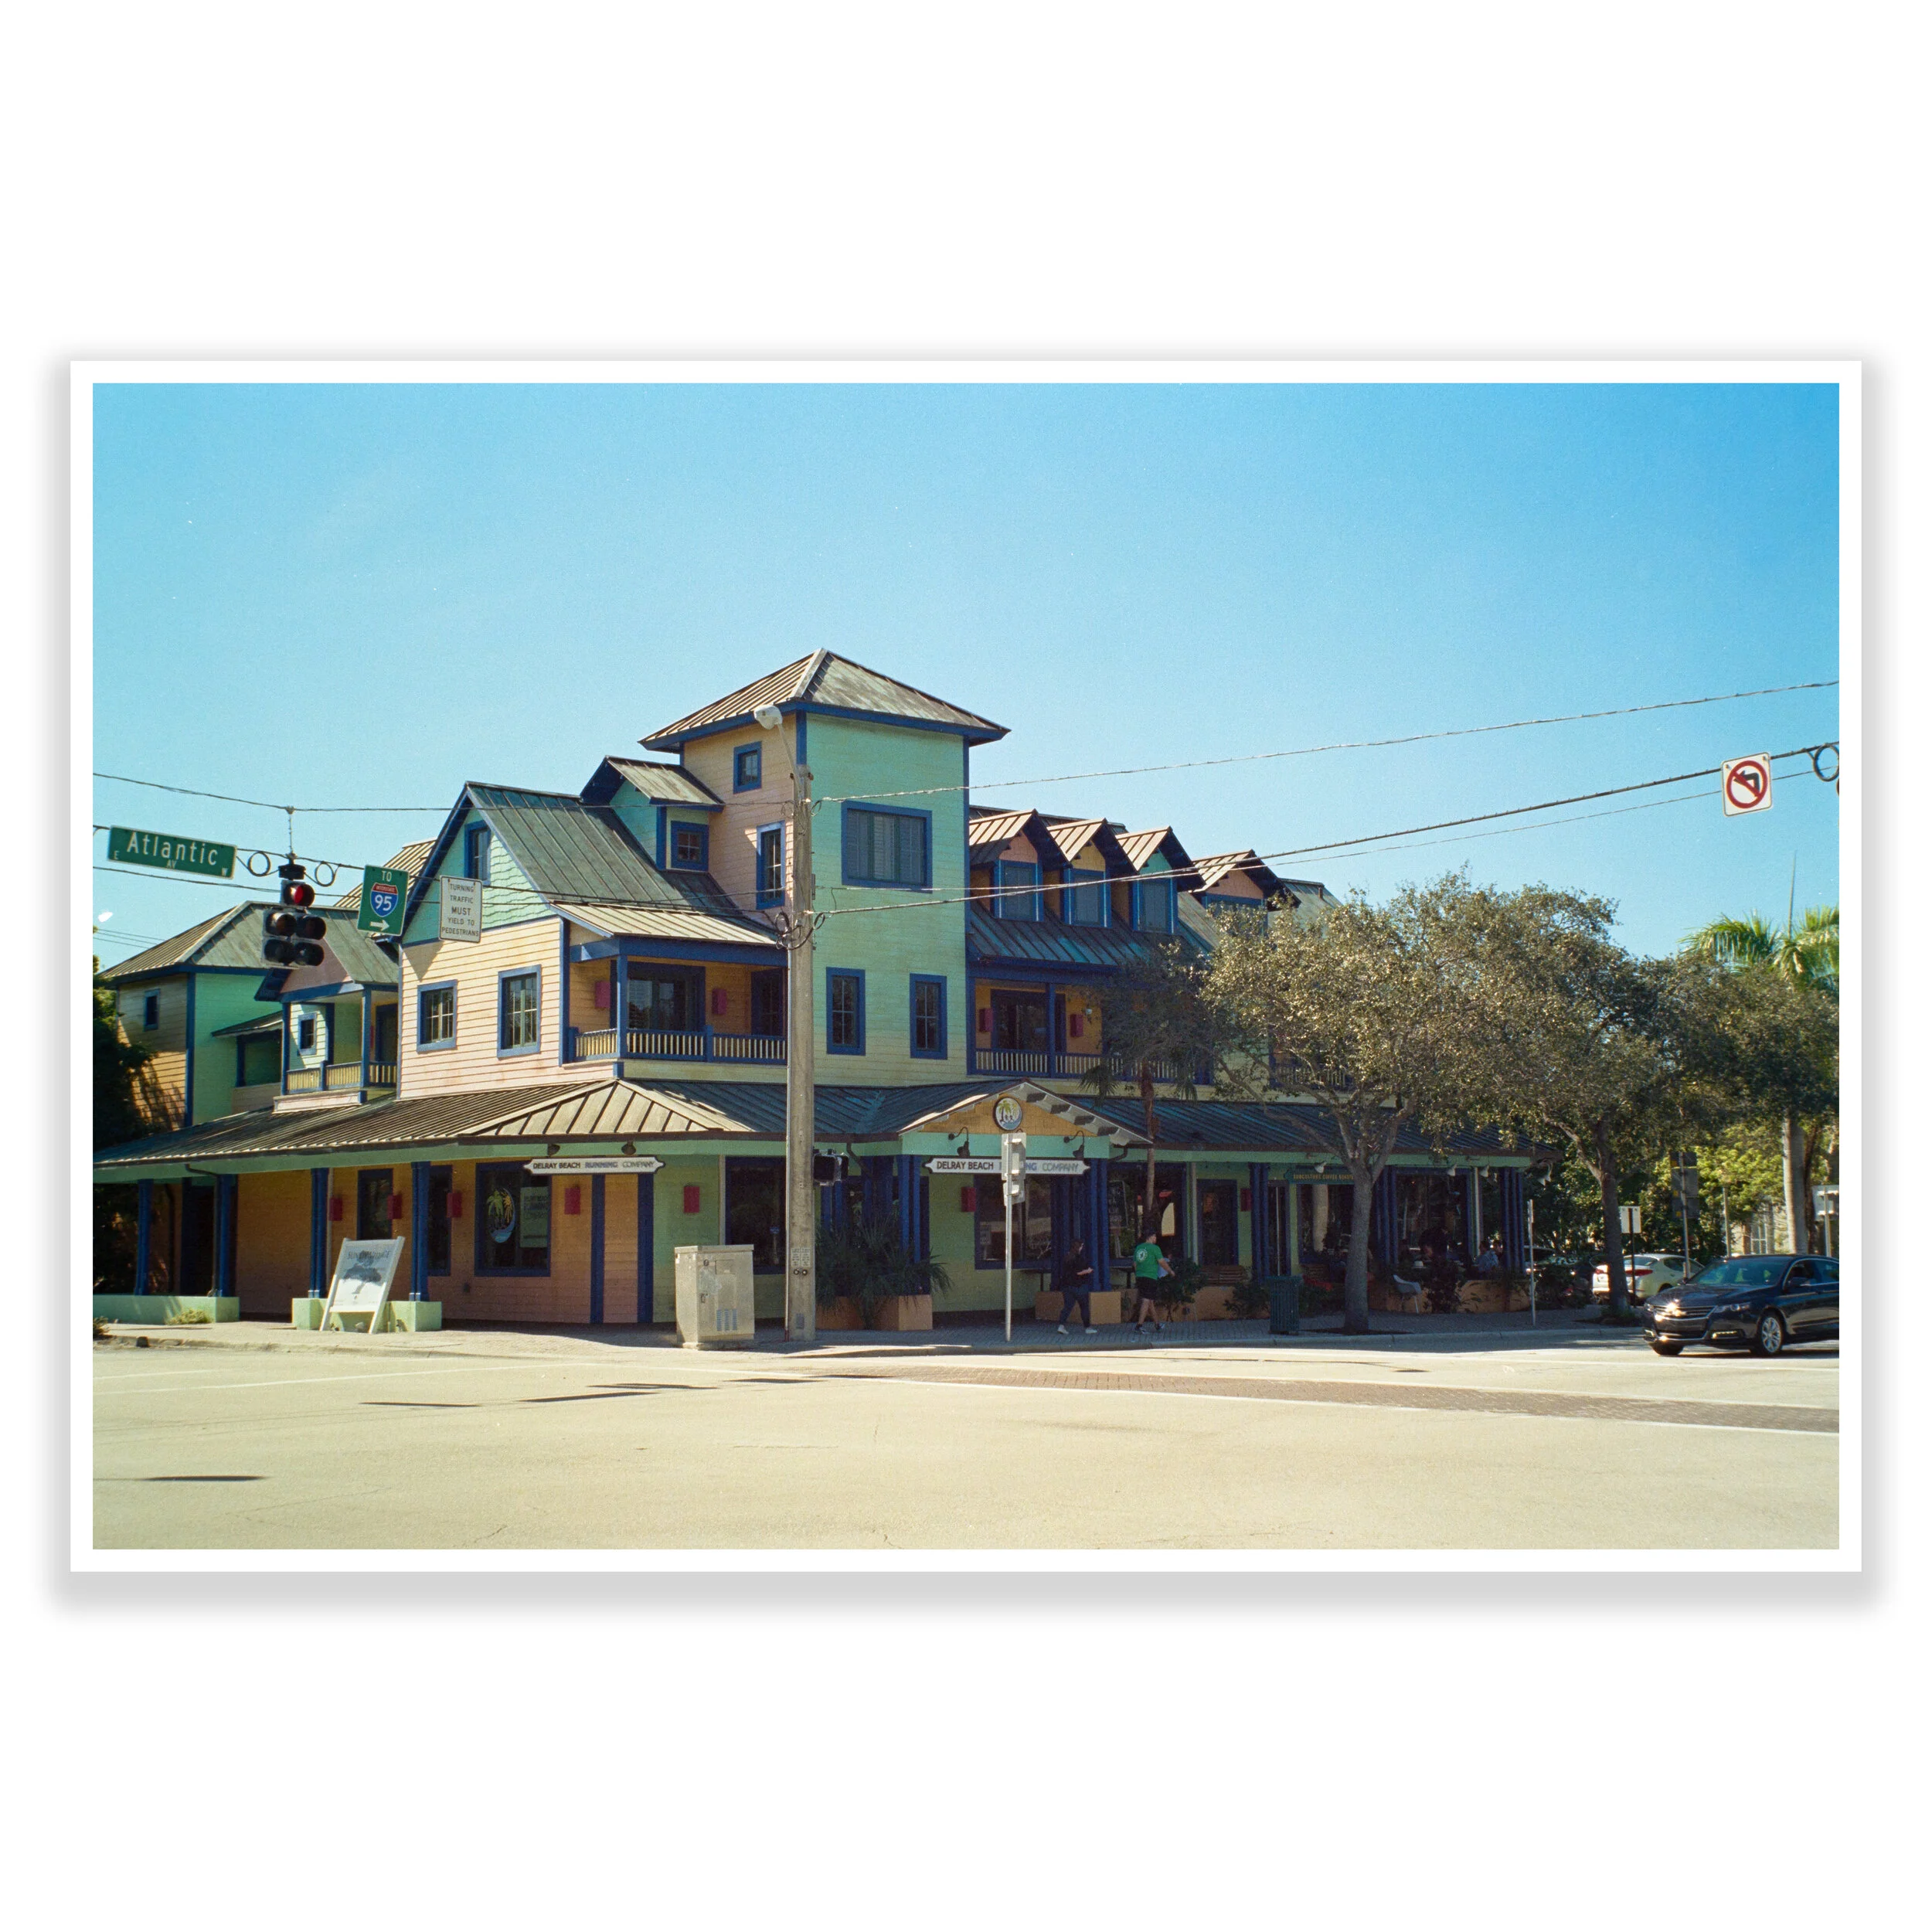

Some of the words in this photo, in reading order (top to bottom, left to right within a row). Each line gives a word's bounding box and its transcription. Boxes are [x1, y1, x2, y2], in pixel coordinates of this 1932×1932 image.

[126, 832, 218, 866] Atlantic
[114, 851, 119, 859] E
[167, 859, 177, 869] AV
[222, 868, 228, 876] W
[382, 870, 392, 882] TO
[450, 883, 474, 893] TURNING
[375, 894, 392, 911] 95
[450, 895, 474, 903] TRAFFIC
[451, 906, 471, 916] MUST
[447, 917, 464, 925] YIELD
[441, 927, 479, 937] PEDESTRIANS
[1043, 1162, 1078, 1171] COMPANY
